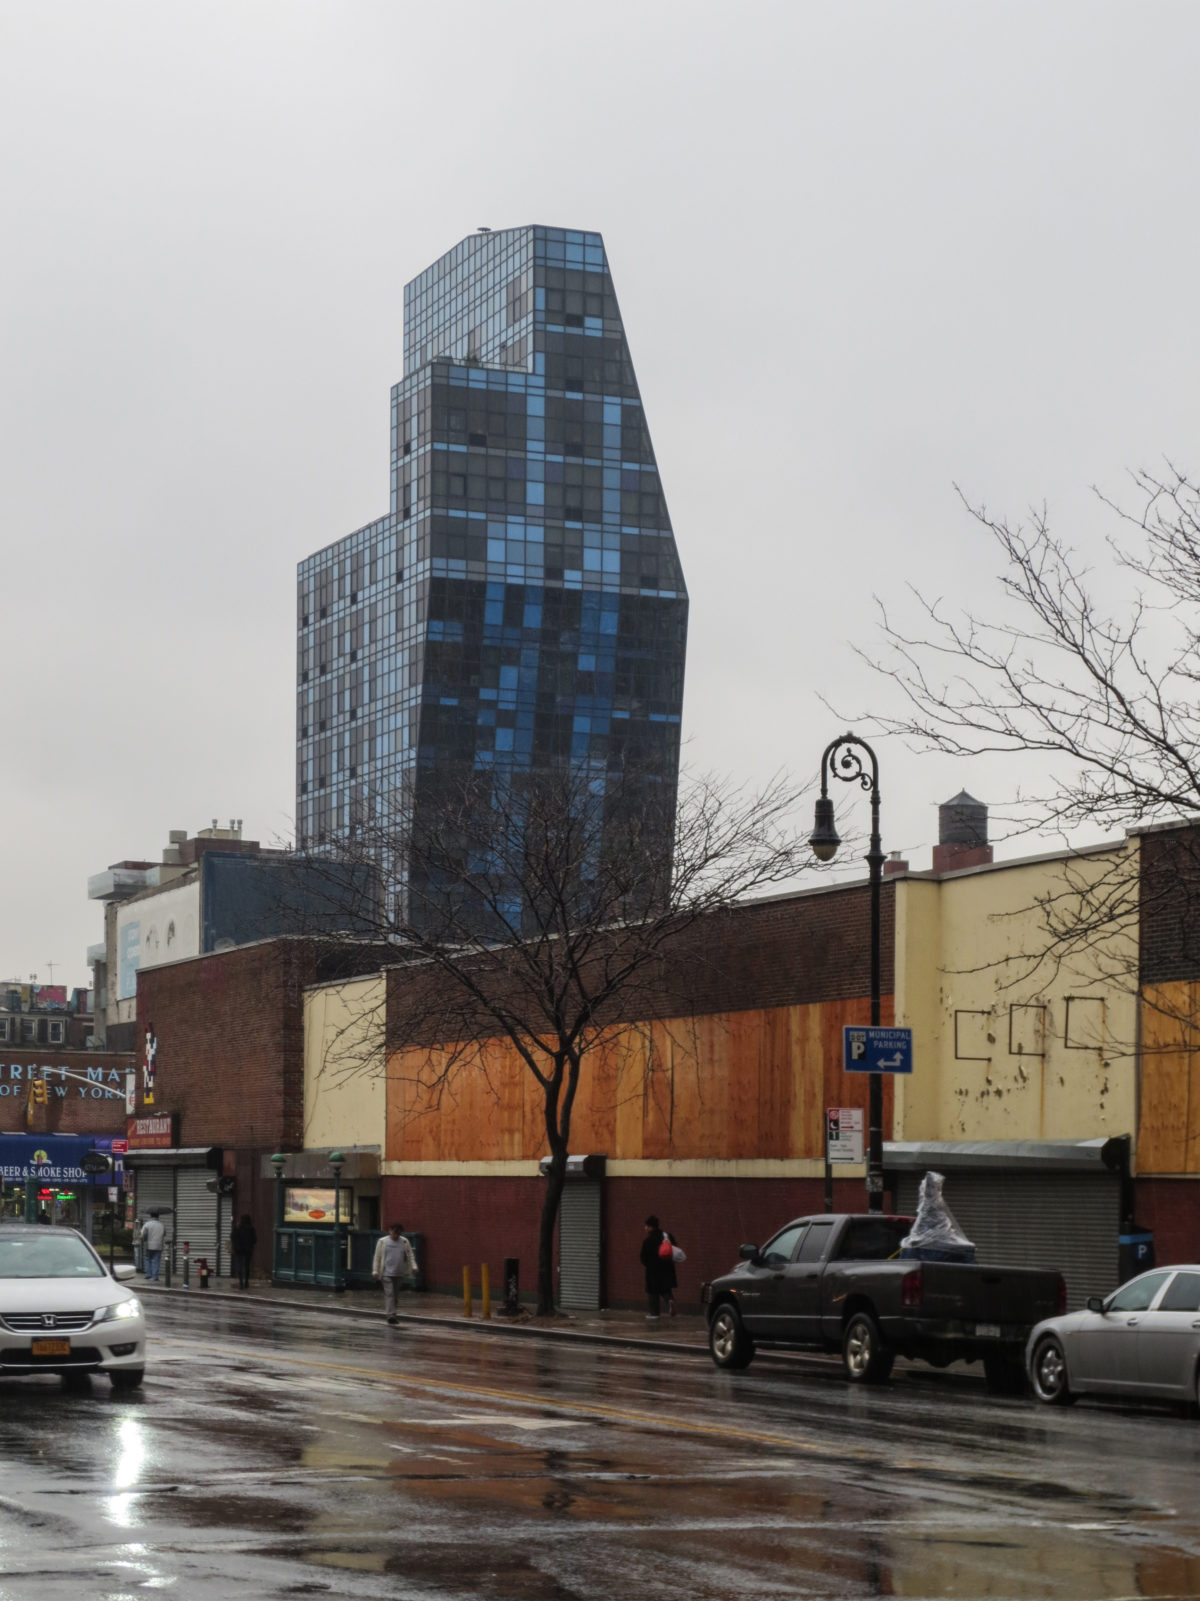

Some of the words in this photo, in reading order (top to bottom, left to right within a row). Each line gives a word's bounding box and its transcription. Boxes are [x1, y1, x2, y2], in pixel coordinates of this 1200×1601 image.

[868, 1030, 910, 1040] MUNICIPAL
[873, 1040, 907, 1049] PARKING
[851, 1042, 865, 1060] P
[0, 1084, 22, 1096] OF
[136, 1118, 171, 1134] RESTAURANT
[22, 1165, 29, 1177] &
[1137, 1244, 1147, 1259] P
